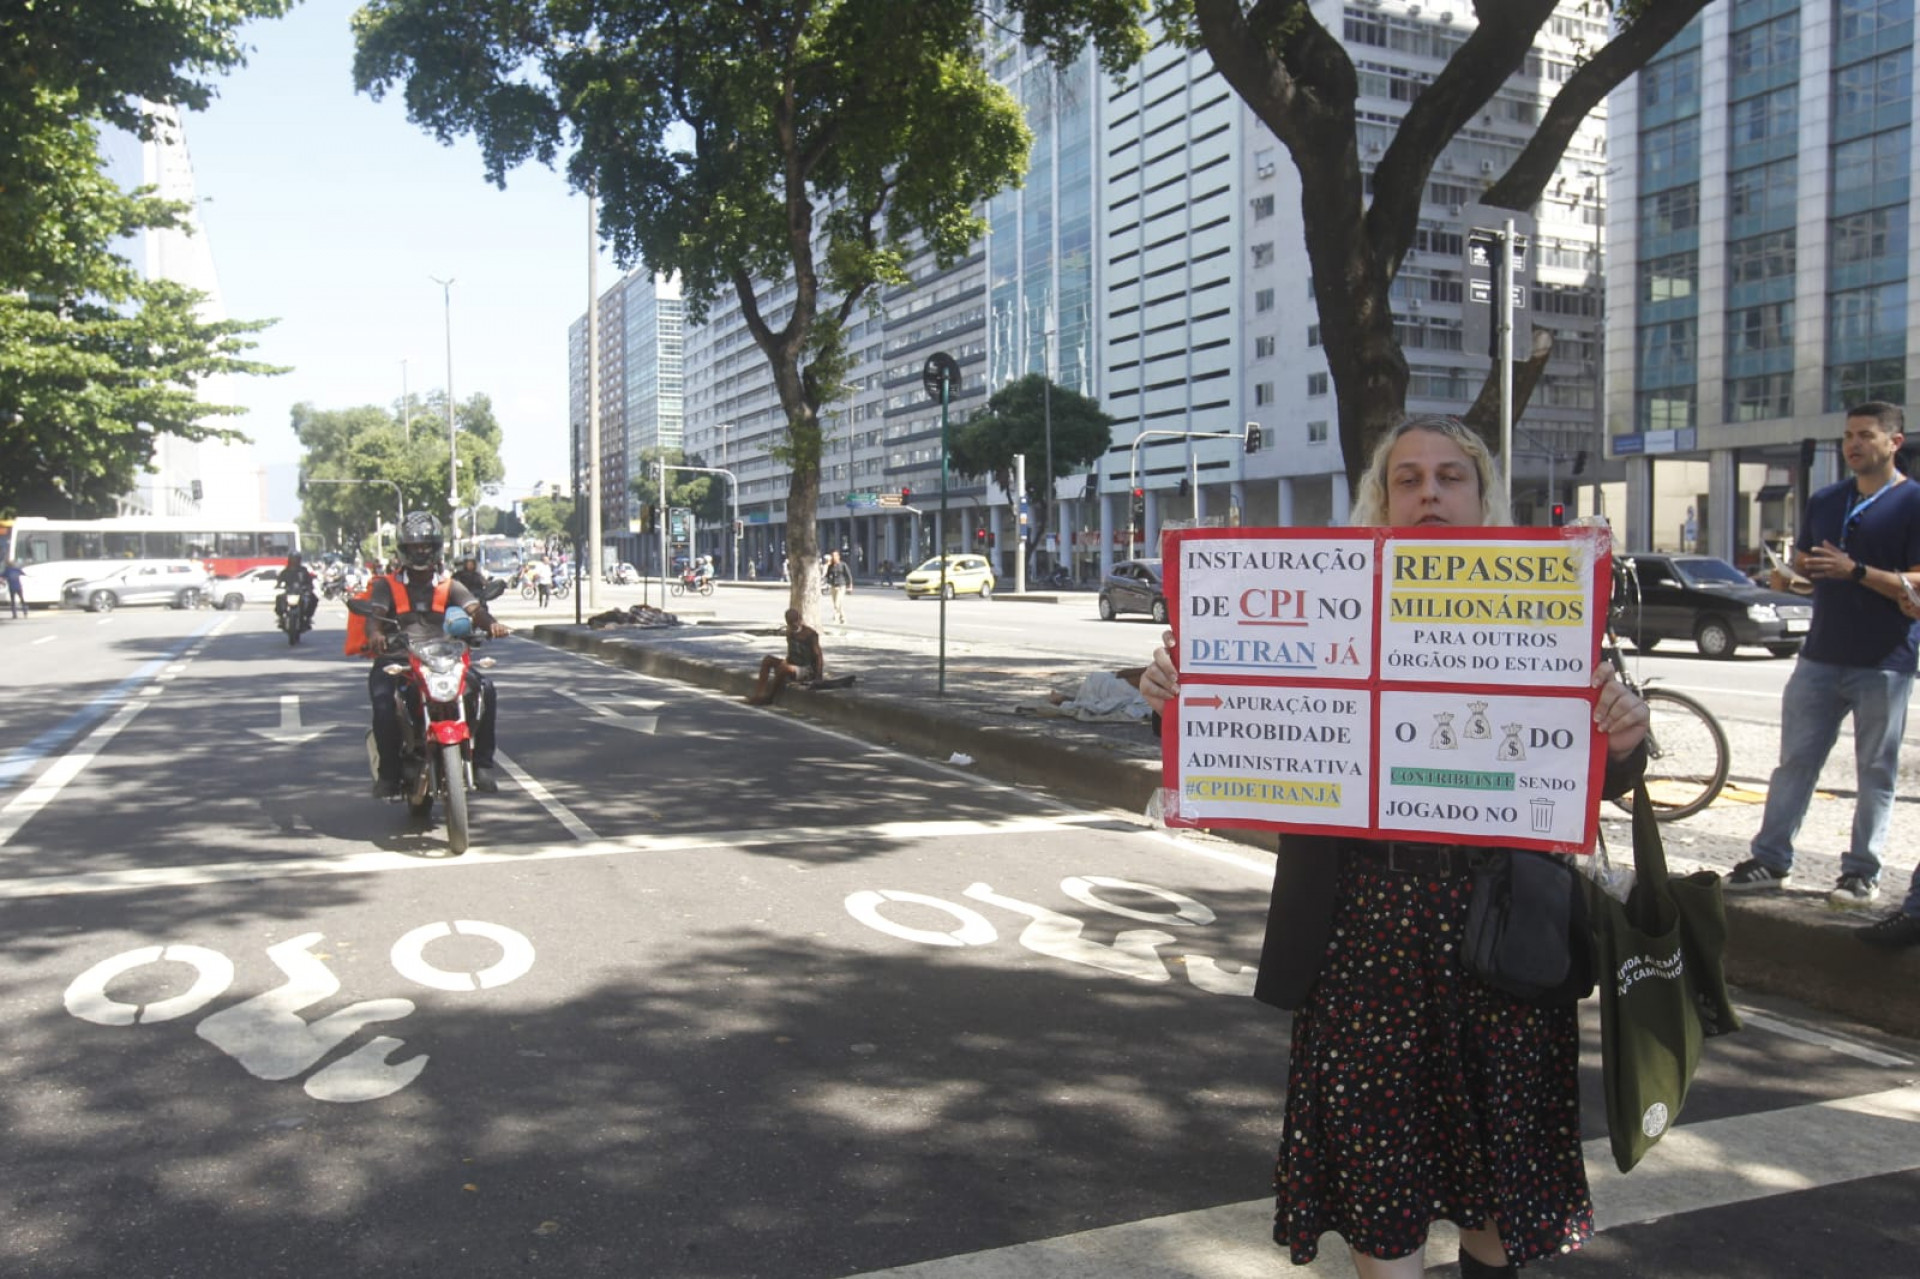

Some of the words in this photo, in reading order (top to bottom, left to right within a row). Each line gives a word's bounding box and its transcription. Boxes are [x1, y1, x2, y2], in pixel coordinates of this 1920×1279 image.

[1188, 548, 1366, 574] INSTAURAÇÃO
[1393, 555, 1578, 583] REPASSES
[1191, 595, 1230, 617] DE
[1239, 588, 1307, 619] CPI
[1317, 598, 1362, 620] NO
[1391, 594, 1583, 620] MILIONÁRIOS
[1413, 630, 1466, 645] PARA
[1472, 631, 1557, 648] OUTROS
[1190, 638, 1316, 664] DETRAN
[1324, 637, 1359, 665] JÁ
[1388, 649, 1466, 669] ÓRGÃOS
[1472, 655, 1499, 670] DO
[1505, 656, 1583, 672] ESTADO
[1223, 695, 1327, 715] APURAÇÃO
[1332, 699, 1357, 715] DE
[1187, 720, 1351, 744] IMPROBIDADE
[1395, 722, 1417, 743] O
[1529, 727, 1574, 749] DO
[1186, 752, 1362, 775] ADMINISTRATIVA
[1391, 769, 1514, 789] CONTRIBUINTE
[1519, 777, 1576, 791] SENDO
[1185, 781, 1341, 804] #CPIDETRANJÁ
[1386, 800, 1479, 822] JOGADO
[1485, 806, 1518, 823] NO
